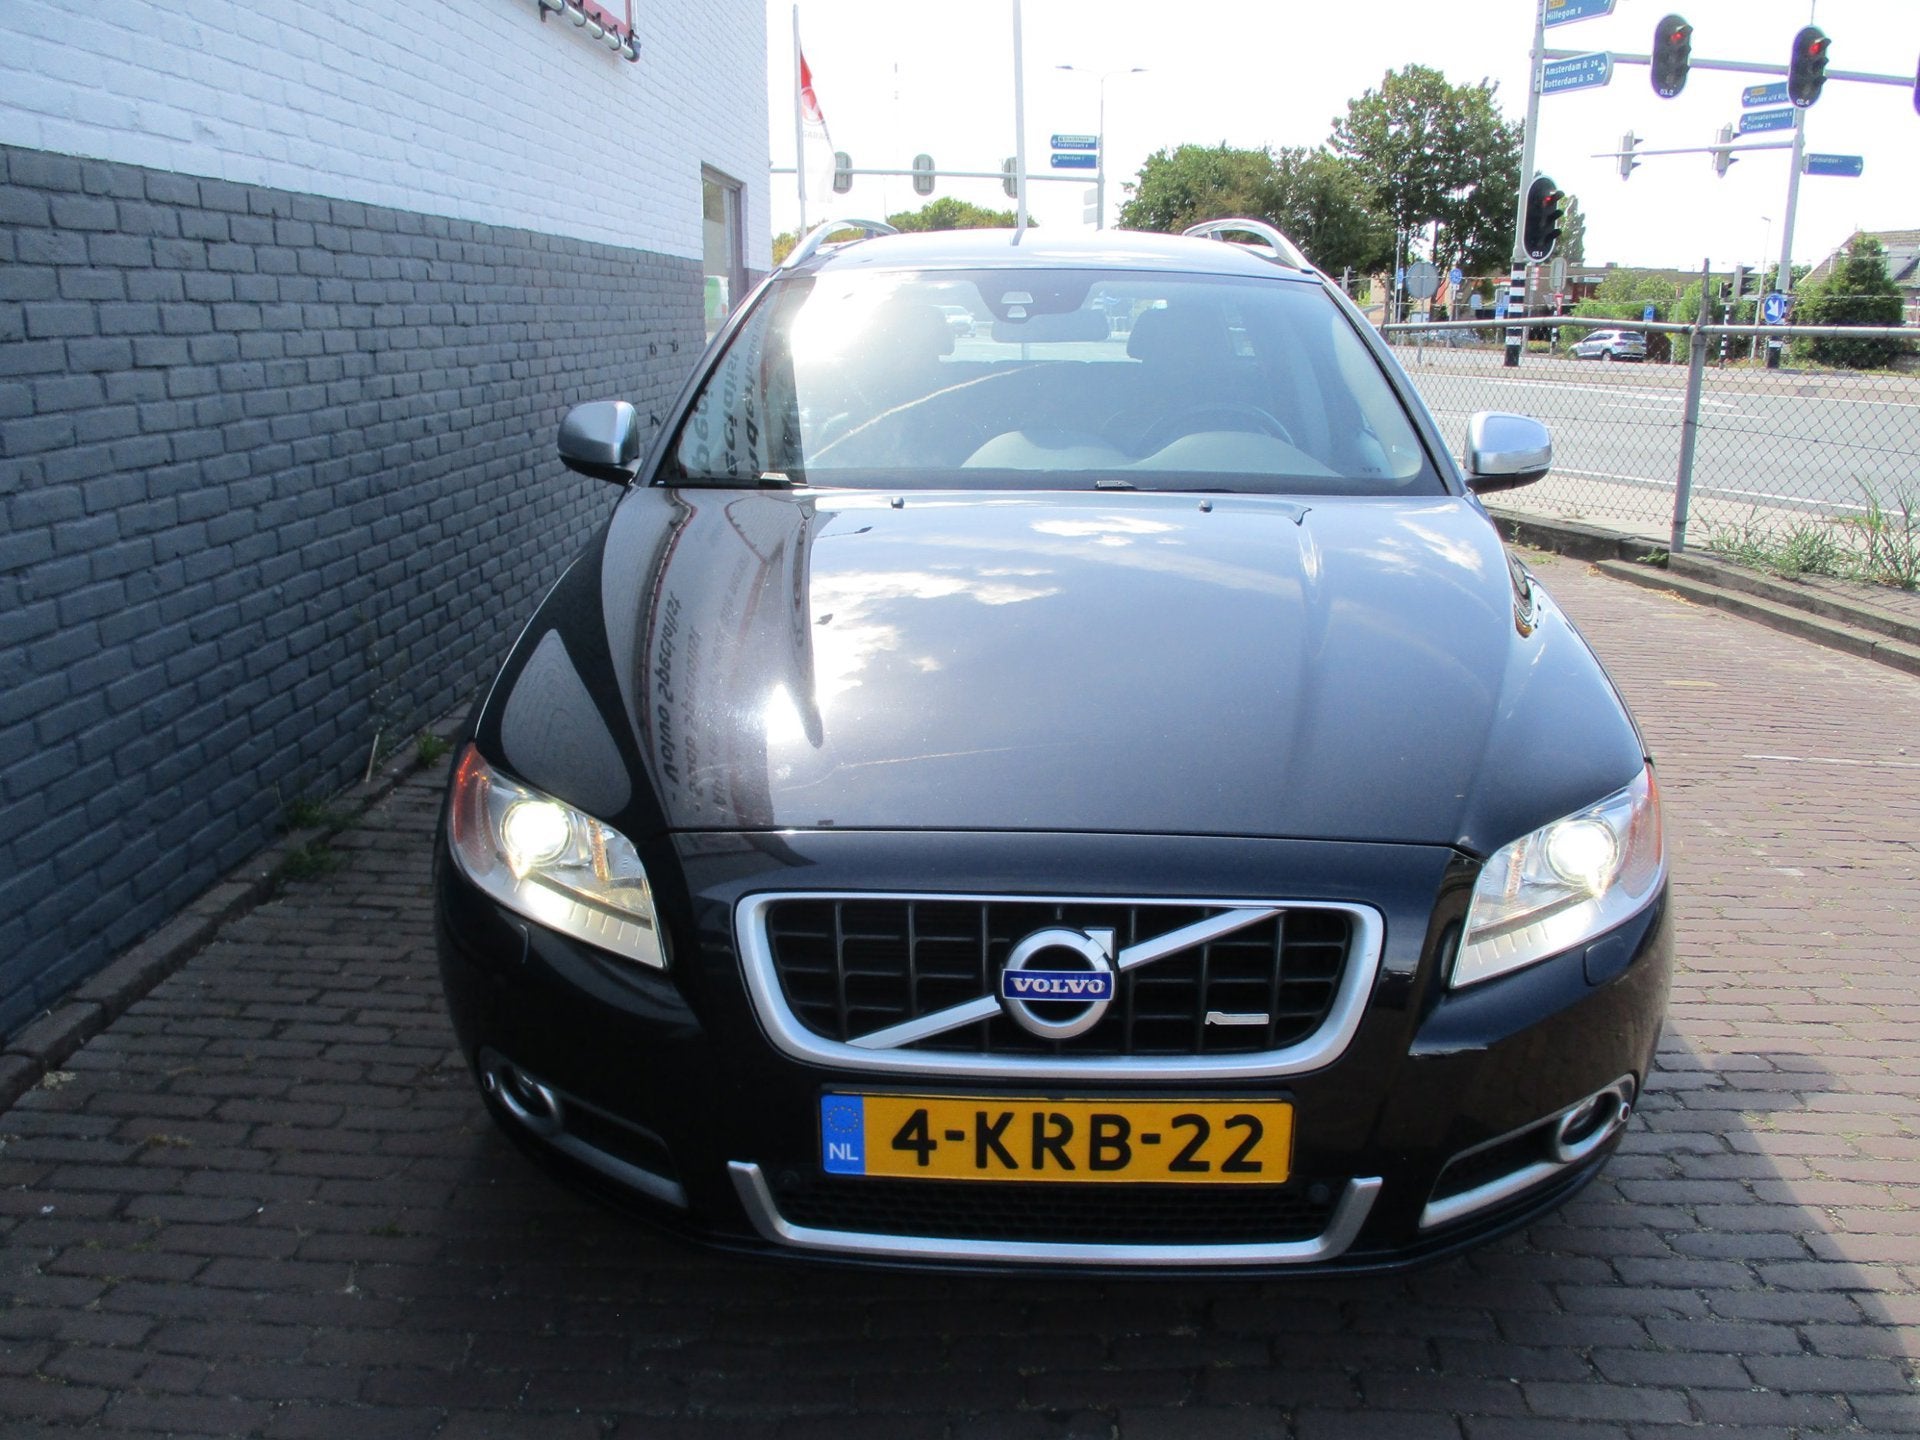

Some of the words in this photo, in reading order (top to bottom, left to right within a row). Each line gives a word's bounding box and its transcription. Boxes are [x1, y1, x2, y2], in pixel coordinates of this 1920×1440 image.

[1546, 8, 1577, 21] Hillegom
[1545, 62, 1582, 76] Amsterdam
[1590, 60, 1599, 68] 24
[1544, 75, 1578, 89] Rotterdam
[1586, 73, 1594, 81] 52
[1010, 977, 1106, 995] VOLVO
[891, 1108, 1265, 1174] 4-KRB-22
[828, 1143, 859, 1162] NL
